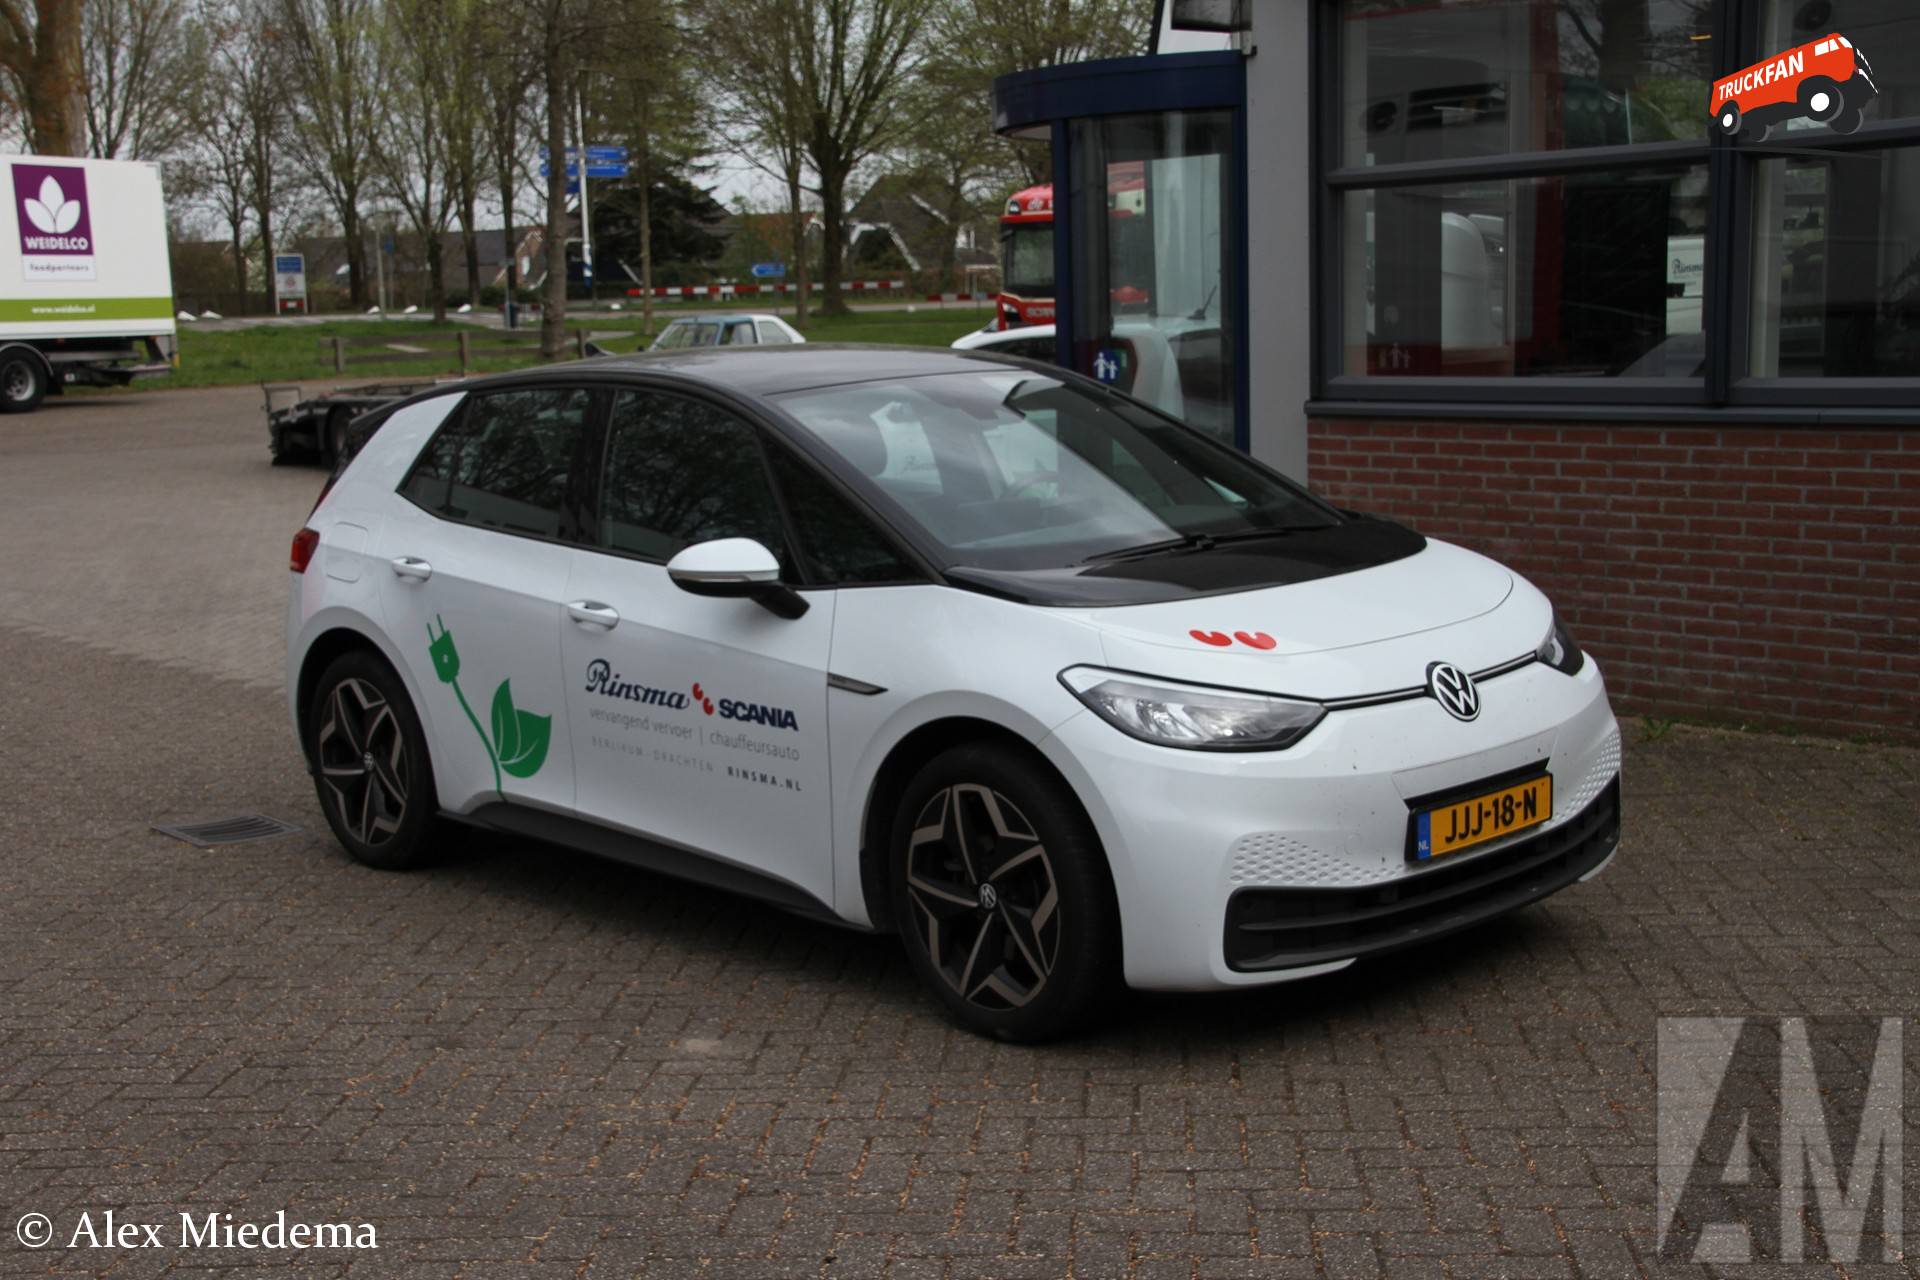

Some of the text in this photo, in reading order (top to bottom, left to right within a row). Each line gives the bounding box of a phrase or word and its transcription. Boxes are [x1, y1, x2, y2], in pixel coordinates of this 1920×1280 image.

[24, 236, 89, 251] WEIDELCO
[585, 658, 799, 731] Rinsma SCANIA
[589, 708, 800, 762] vervangend vervoer chauffeursauto
[728, 765, 802, 791] RINSMA.NL
[1445, 786, 1537, 845] JJJ-18-N
[1417, 839, 1430, 851] NL
